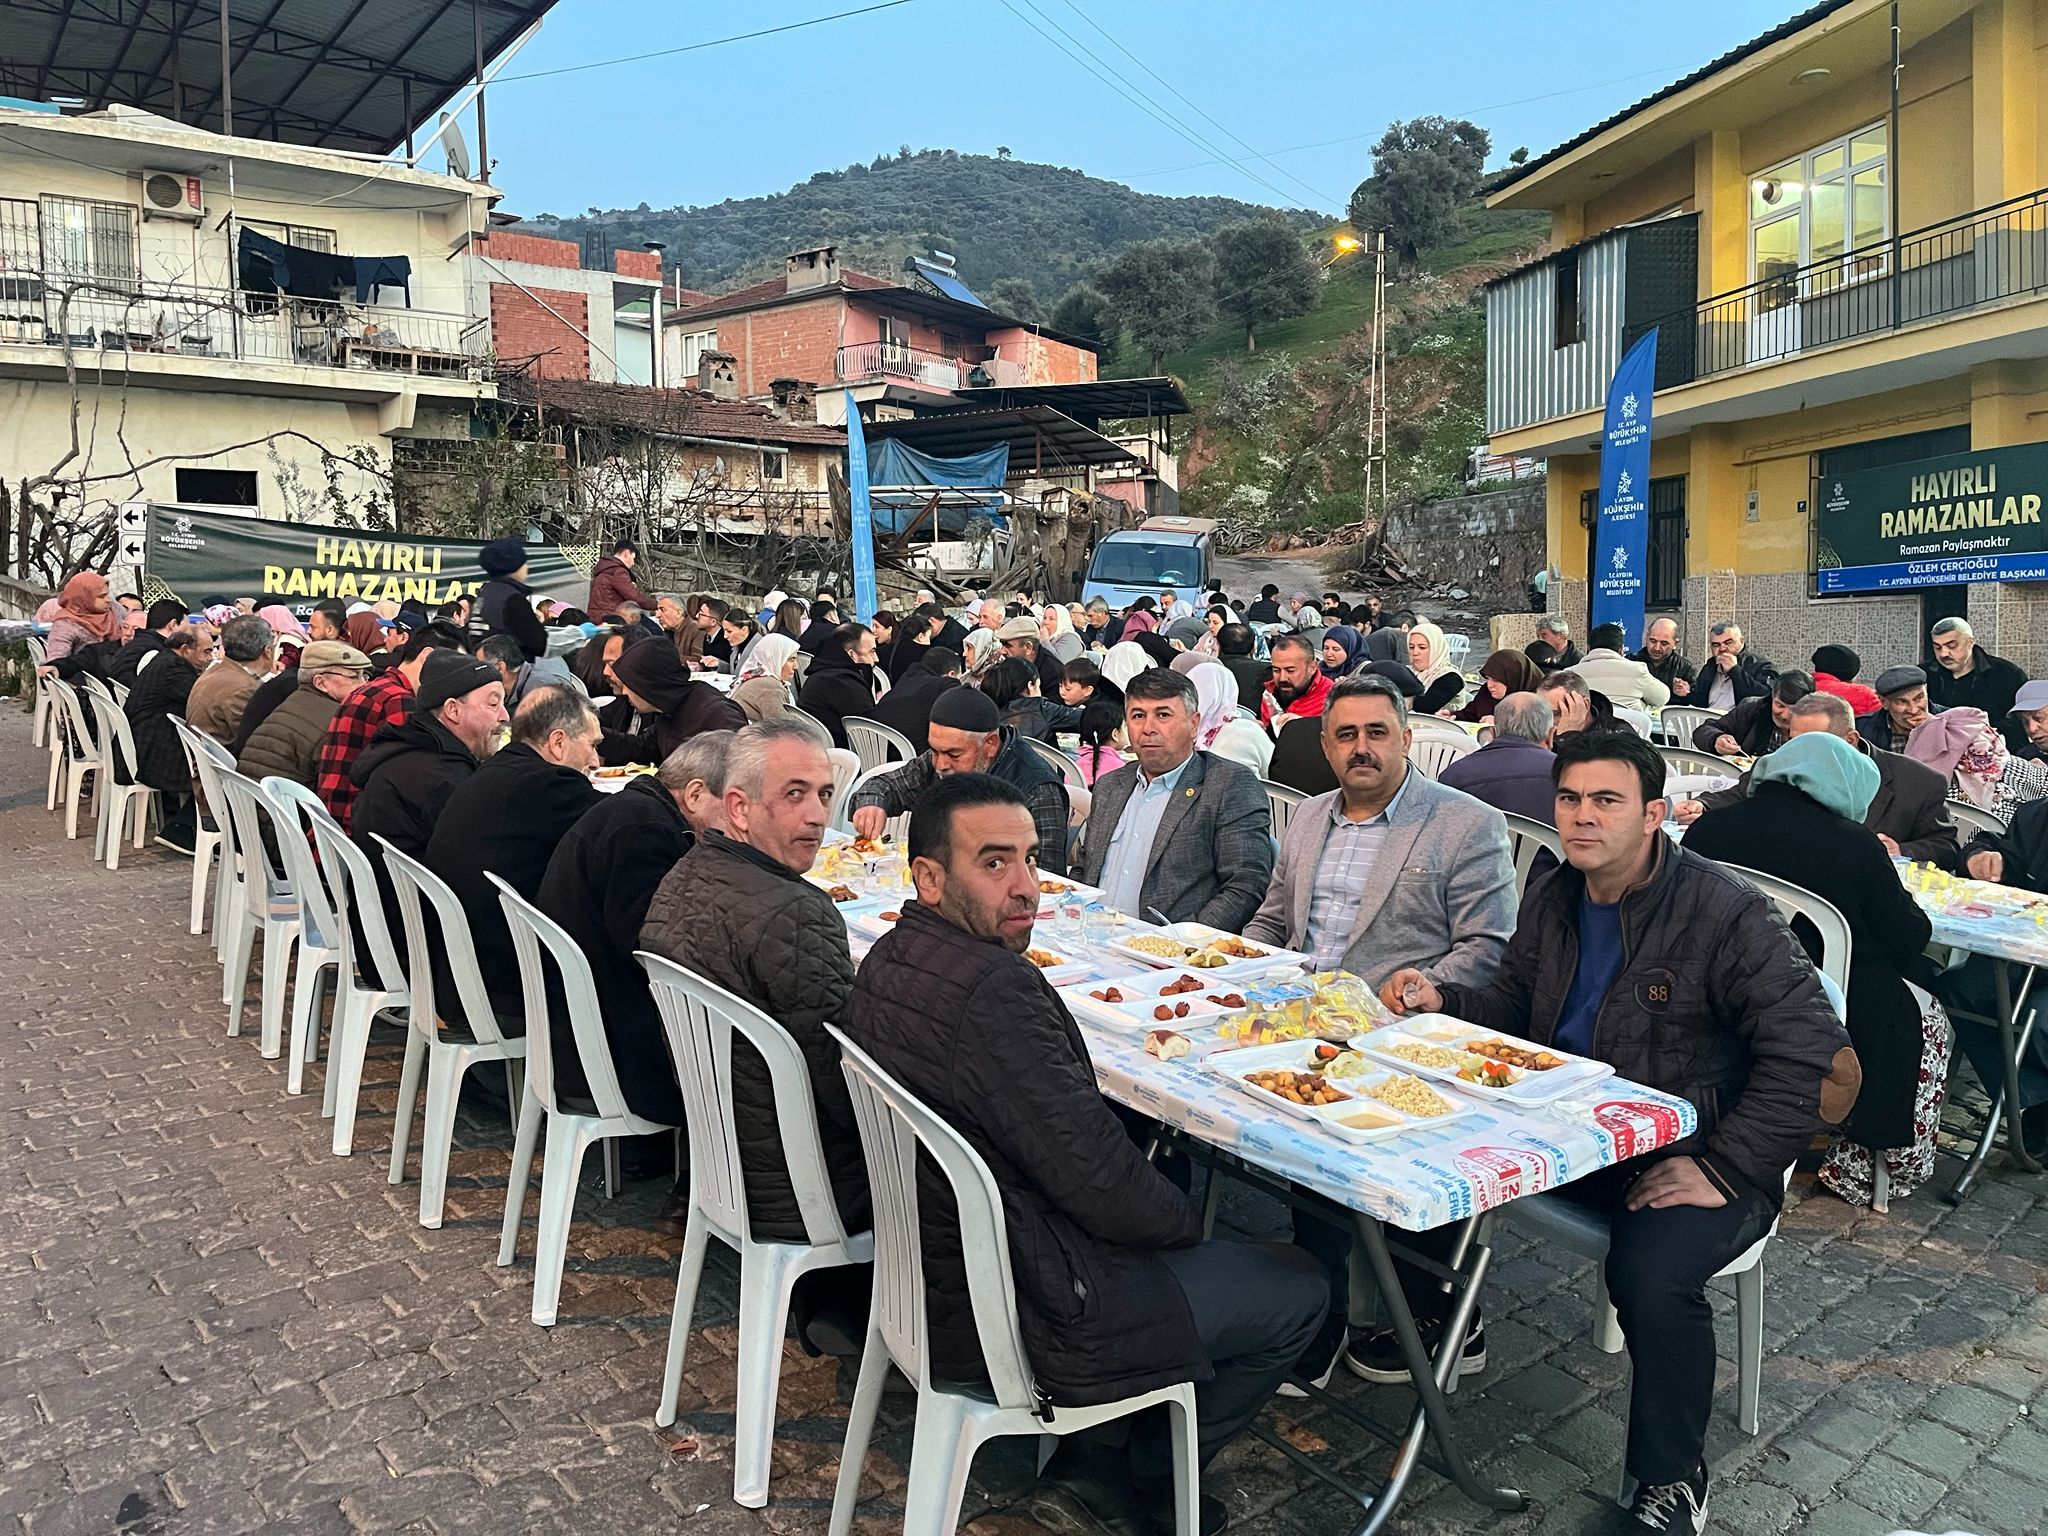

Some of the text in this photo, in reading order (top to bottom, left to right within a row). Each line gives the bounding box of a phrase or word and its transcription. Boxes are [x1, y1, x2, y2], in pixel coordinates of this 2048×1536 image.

[1911, 464, 1996, 503] HAYIRLI
[1880, 494, 2041, 539] RAMAZANLAR
[160, 535, 206, 546] BÜYÜKŞEHİR
[1900, 536, 2011, 556] Ramazan Paylaşmaktır
[316, 537, 442, 575] HAYIRLI
[1908, 558, 1998, 574] ÖZLEM ÇERÇİOĞLU
[1599, 577, 1641, 589] BÜYÜKŞEHİR
[1891, 577, 1912, 586] AYDIN
[1913, 573, 1956, 585] BÜYÜKŞEHİR
[1957, 571, 1997, 581] BELEDİYE
[1999, 568, 2045, 580] BAŞKANI
[1648, 985, 1668, 1002] 88
